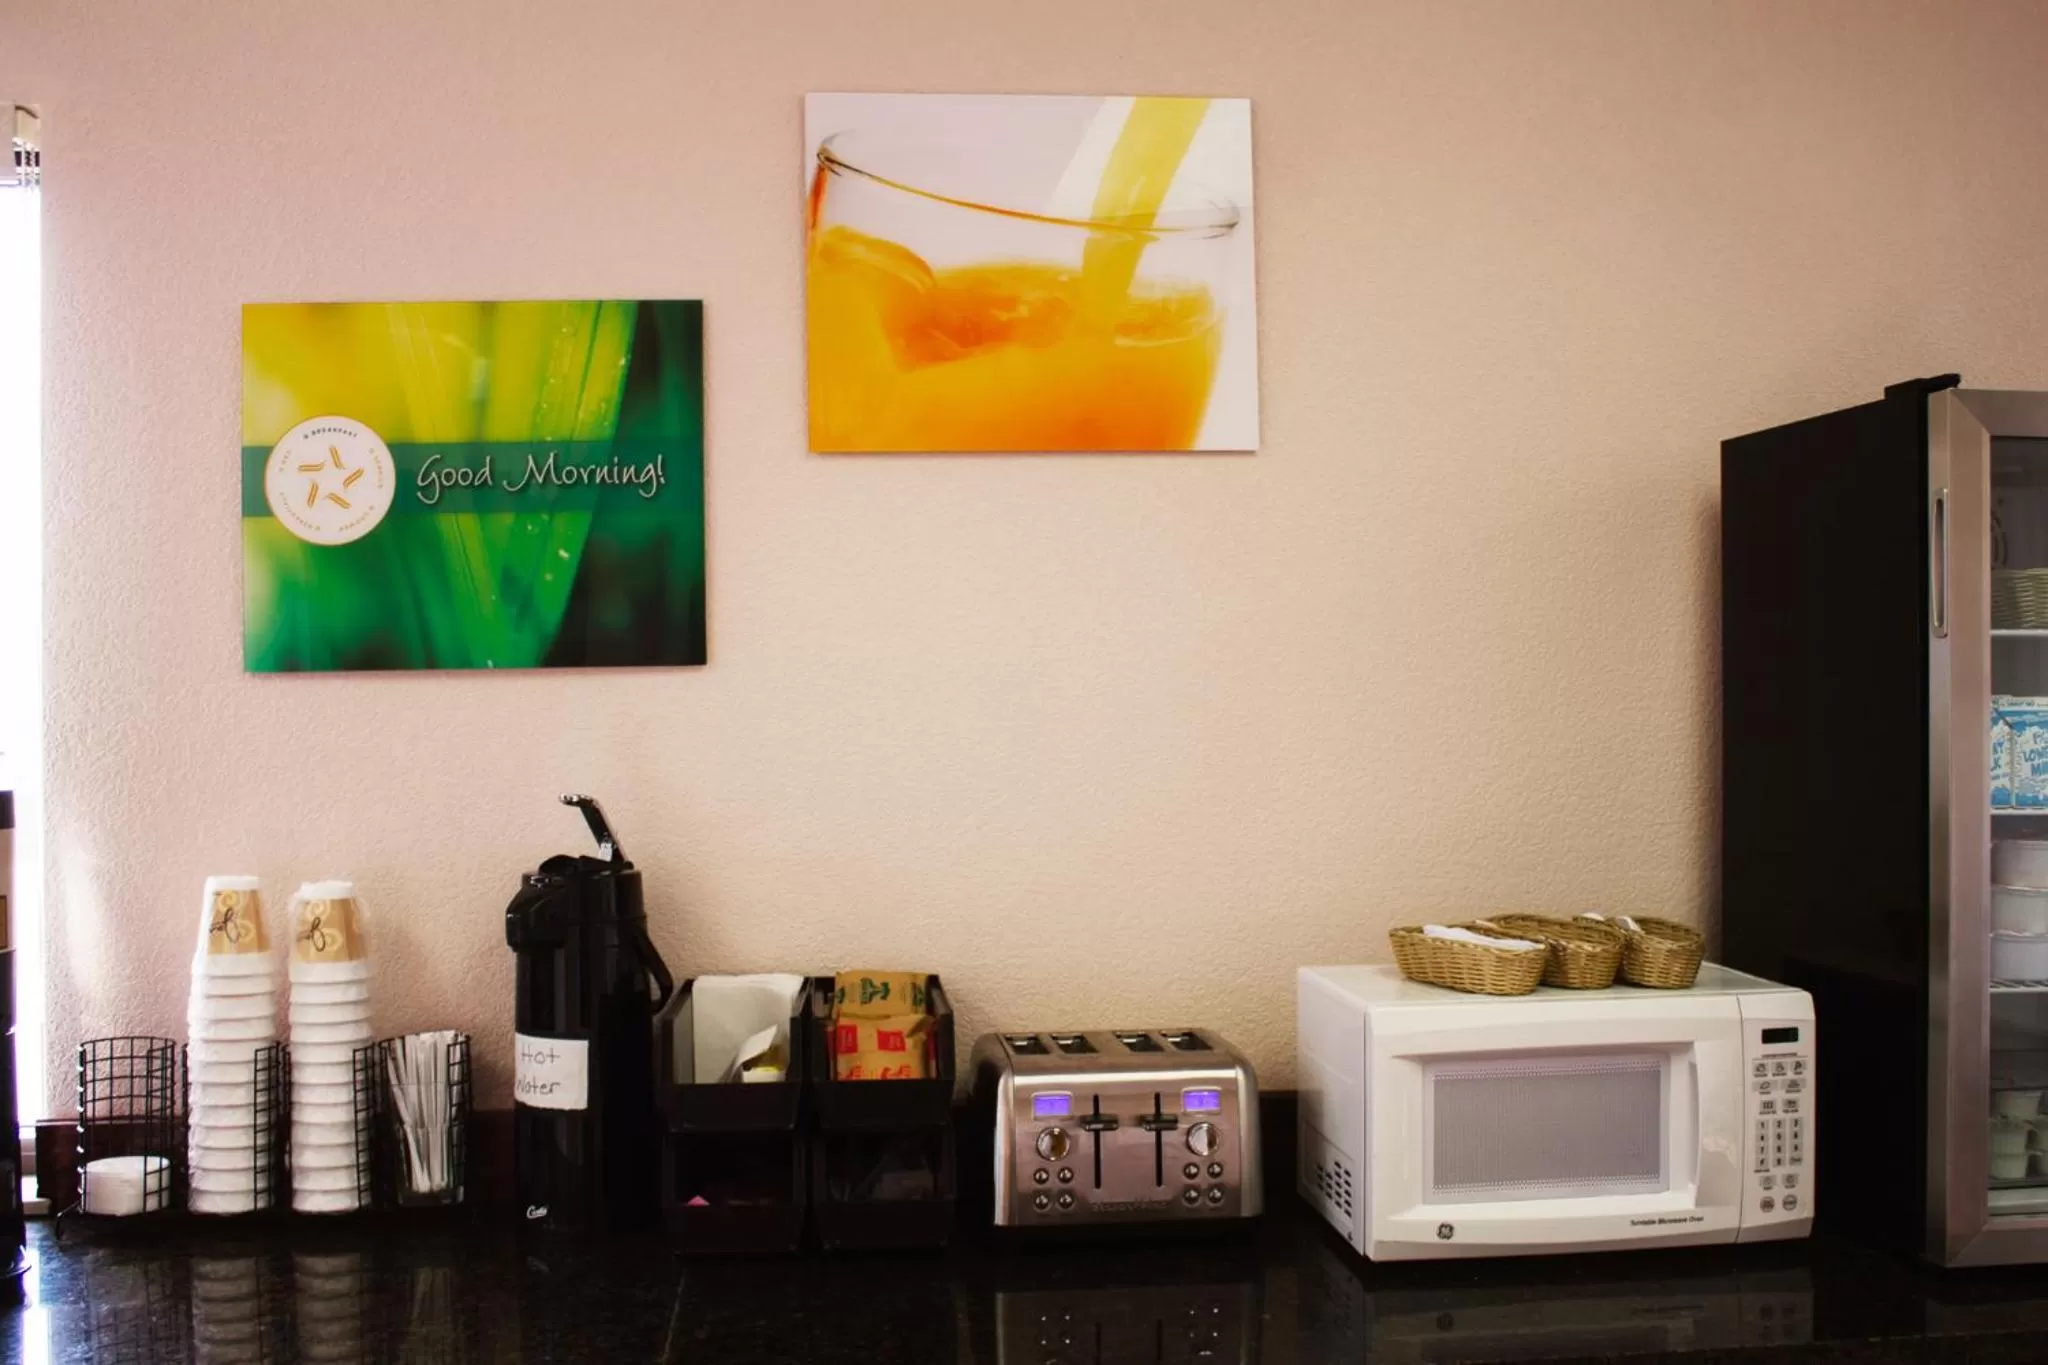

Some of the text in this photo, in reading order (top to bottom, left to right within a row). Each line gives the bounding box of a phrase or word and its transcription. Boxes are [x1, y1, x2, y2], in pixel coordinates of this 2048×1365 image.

[416, 453, 494, 505] Good
[502, 451, 667, 499] Morning!
[521, 1043, 561, 1064] Hot
